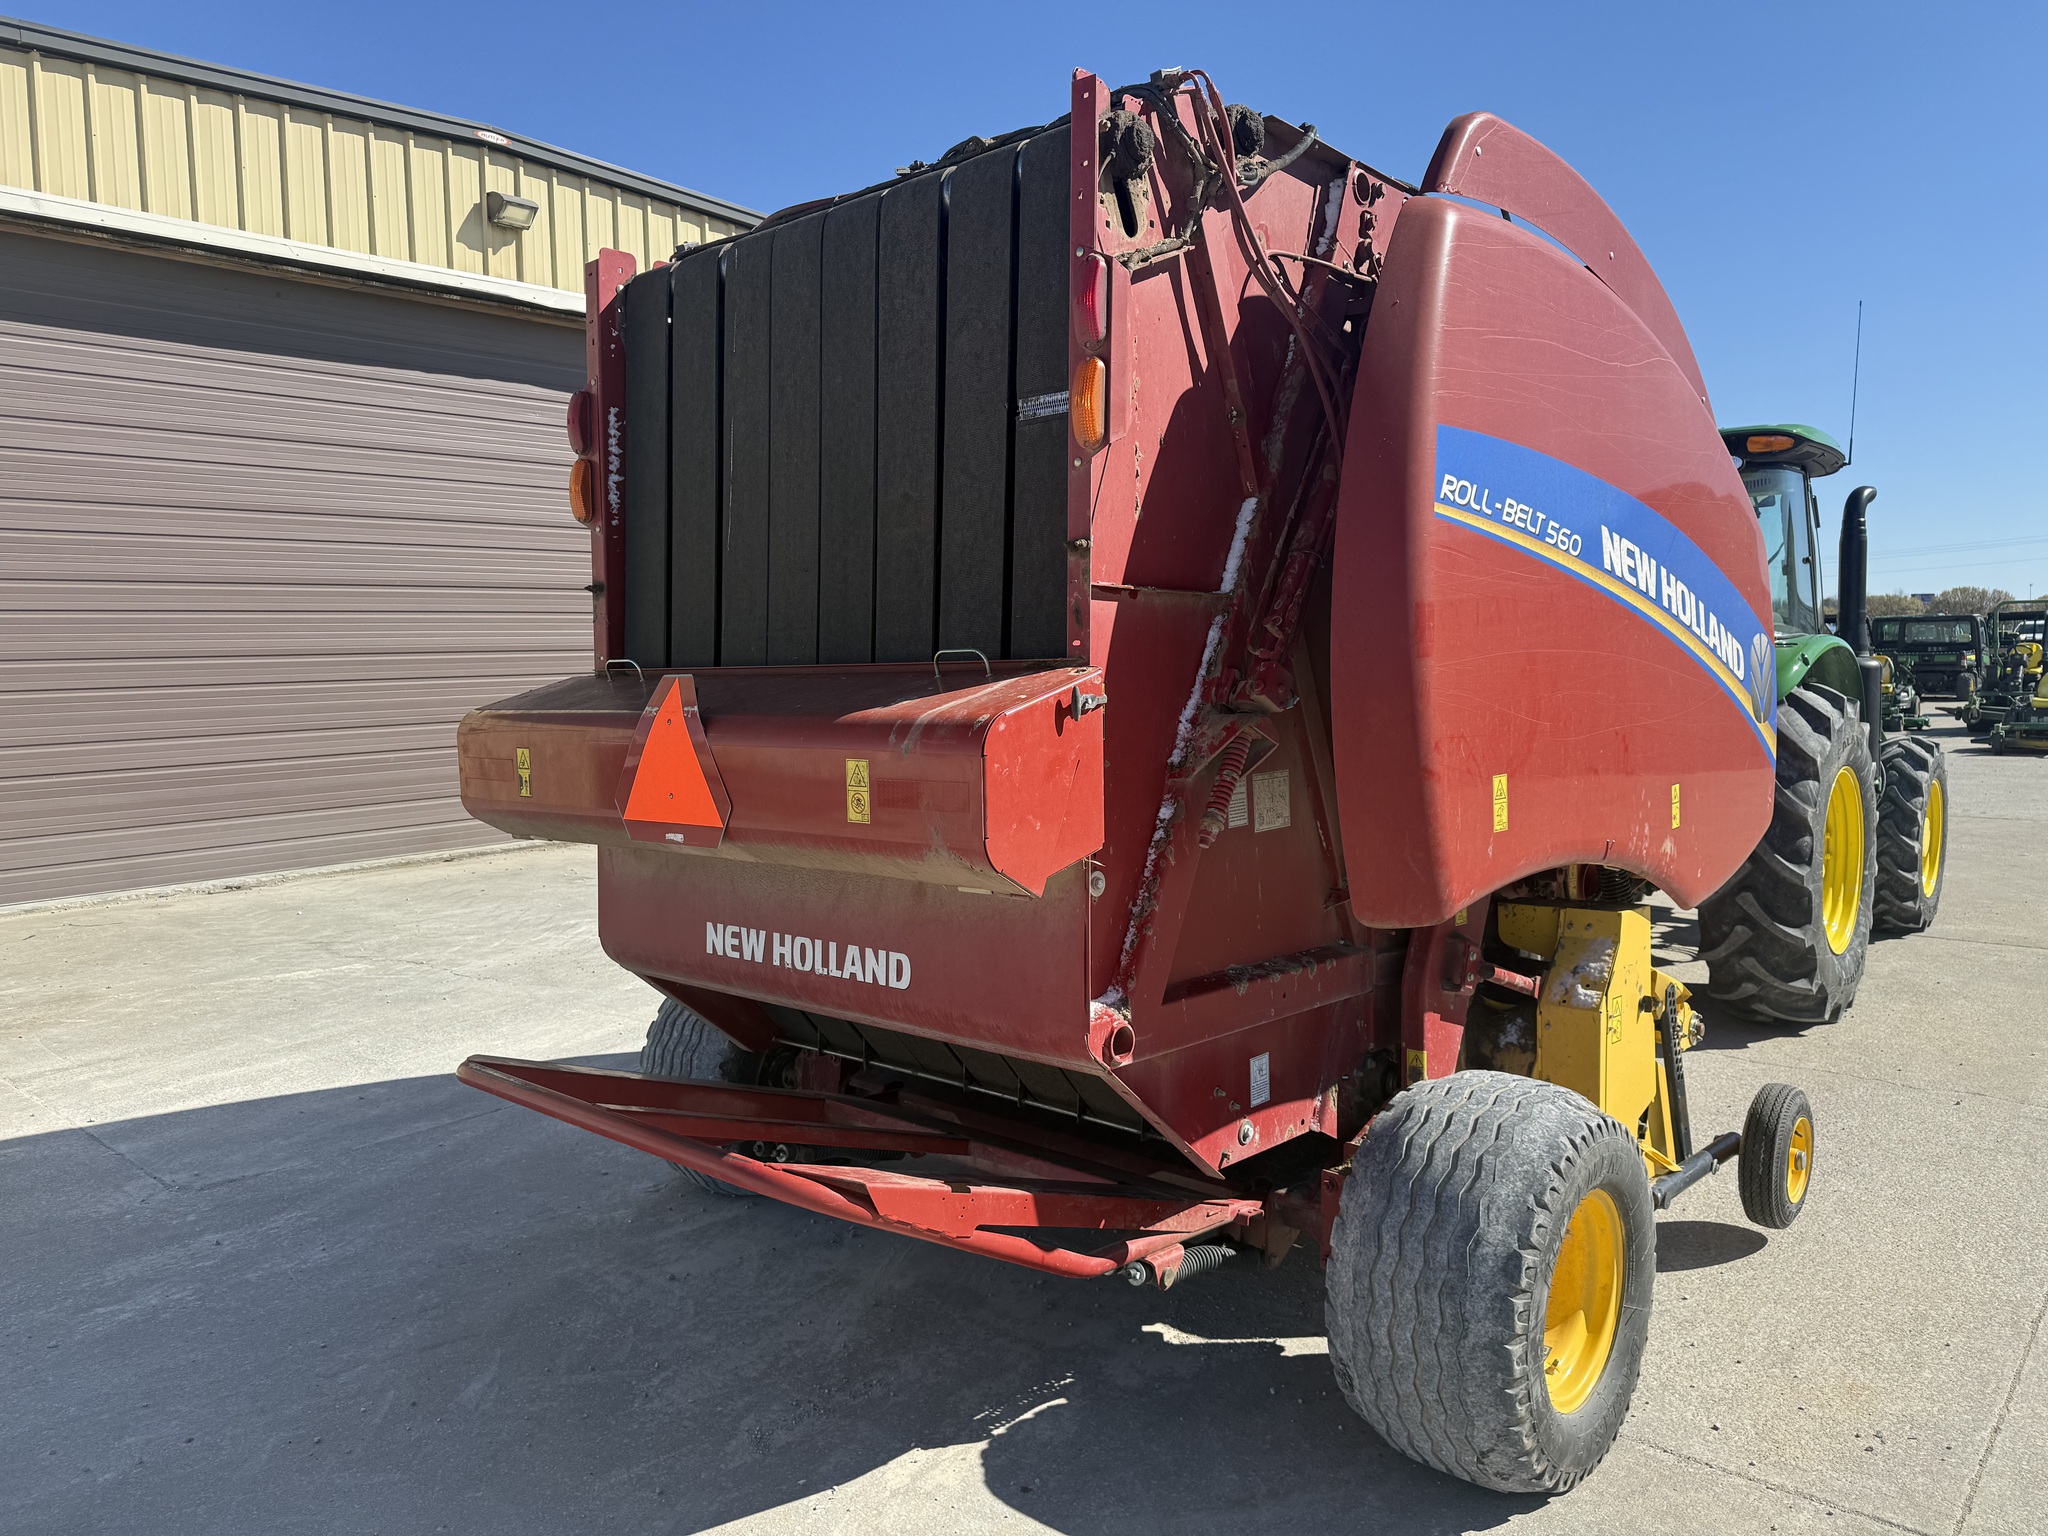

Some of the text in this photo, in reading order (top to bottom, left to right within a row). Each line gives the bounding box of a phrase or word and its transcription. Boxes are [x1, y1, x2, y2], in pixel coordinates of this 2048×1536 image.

[481, 133, 505, 142] BUTLER
[1439, 473, 1582, 558] ROLL-BELT 560
[1600, 524, 1746, 682] NEW HOLLAND
[706, 921, 912, 990] NEW HOLLAND
